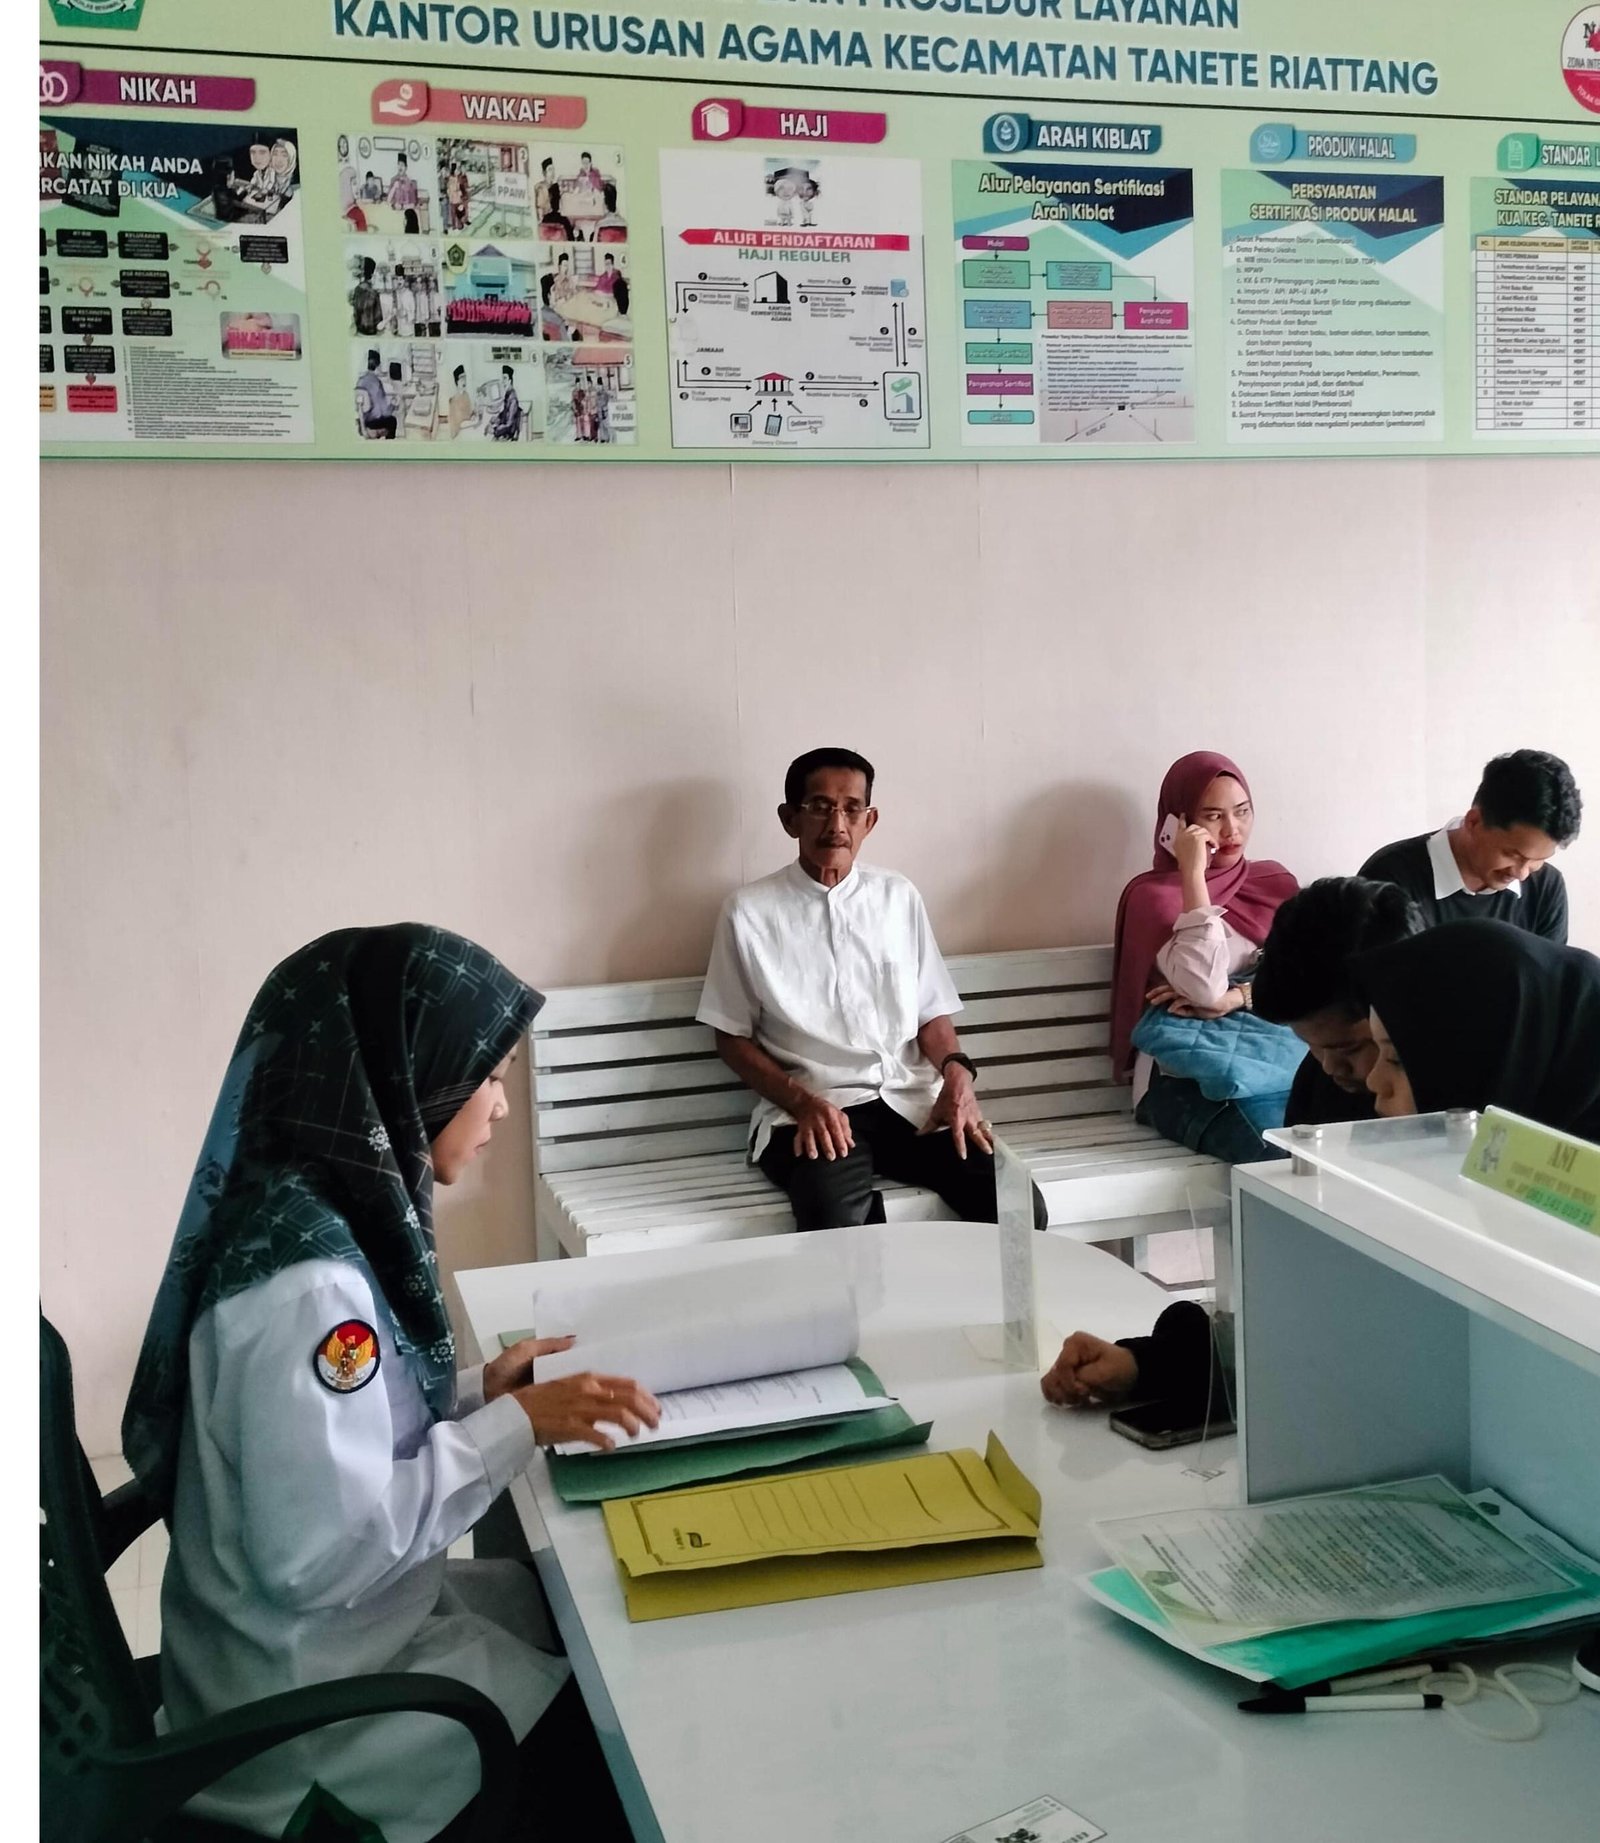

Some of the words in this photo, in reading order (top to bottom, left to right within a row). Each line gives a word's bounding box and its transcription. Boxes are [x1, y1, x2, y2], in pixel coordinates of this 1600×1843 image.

[1075, 0, 1238, 28] LAYANAN
[334, 0, 520, 47] KANTOR
[533, 9, 705, 58] URUSAN
[718, 23, 872, 68] AGAMA
[884, 33, 1116, 80] KECAMATAN
[1128, 47, 1259, 87] TANETE
[1269, 54, 1438, 95] RIATTANG
[120, 76, 197, 104] NIKAH
[461, 94, 546, 123] WAKAF
[780, 113, 828, 137] HAJI
[1037, 125, 1086, 148] ARAH
[1092, 128, 1151, 150] KIBLAT
[1308, 136, 1358, 158] PRODUK
[1359, 137, 1396, 159] HALAL
[87, 154, 145, 173] NIKAH
[151, 157, 203, 175] ANDA
[1542, 144, 1592, 166] STANDAR
[40, 178, 112, 196] RCATAT
[118, 179, 136, 196] DI
[143, 181, 179, 199] KUA
[979, 173, 1012, 192] Alur
[1014, 175, 1091, 198] Pelayanan
[1094, 178, 1165, 197] Sertifikasi
[1292, 183, 1376, 200] PERSYARATAN
[1495, 188, 1548, 205] STANDAR
[1550, 191, 1600, 206] PELAYAN
[1032, 202, 1068, 220] Arah
[1071, 203, 1115, 221] Kiblat
[1250, 204, 1323, 222] SERTIFIKASI
[1325, 207, 1376, 222] PRODUK
[1379, 208, 1417, 223] HALAL
[1497, 210, 1521, 226] KUA
[1523, 211, 1549, 227] KEC.
[1552, 212, 1593, 228] TANETE
[713, 231, 757, 245] ALUR
[762, 233, 876, 249] PENDAFTARAN
[738, 248, 773, 261] HAJI
[778, 250, 851, 263] REGULER
